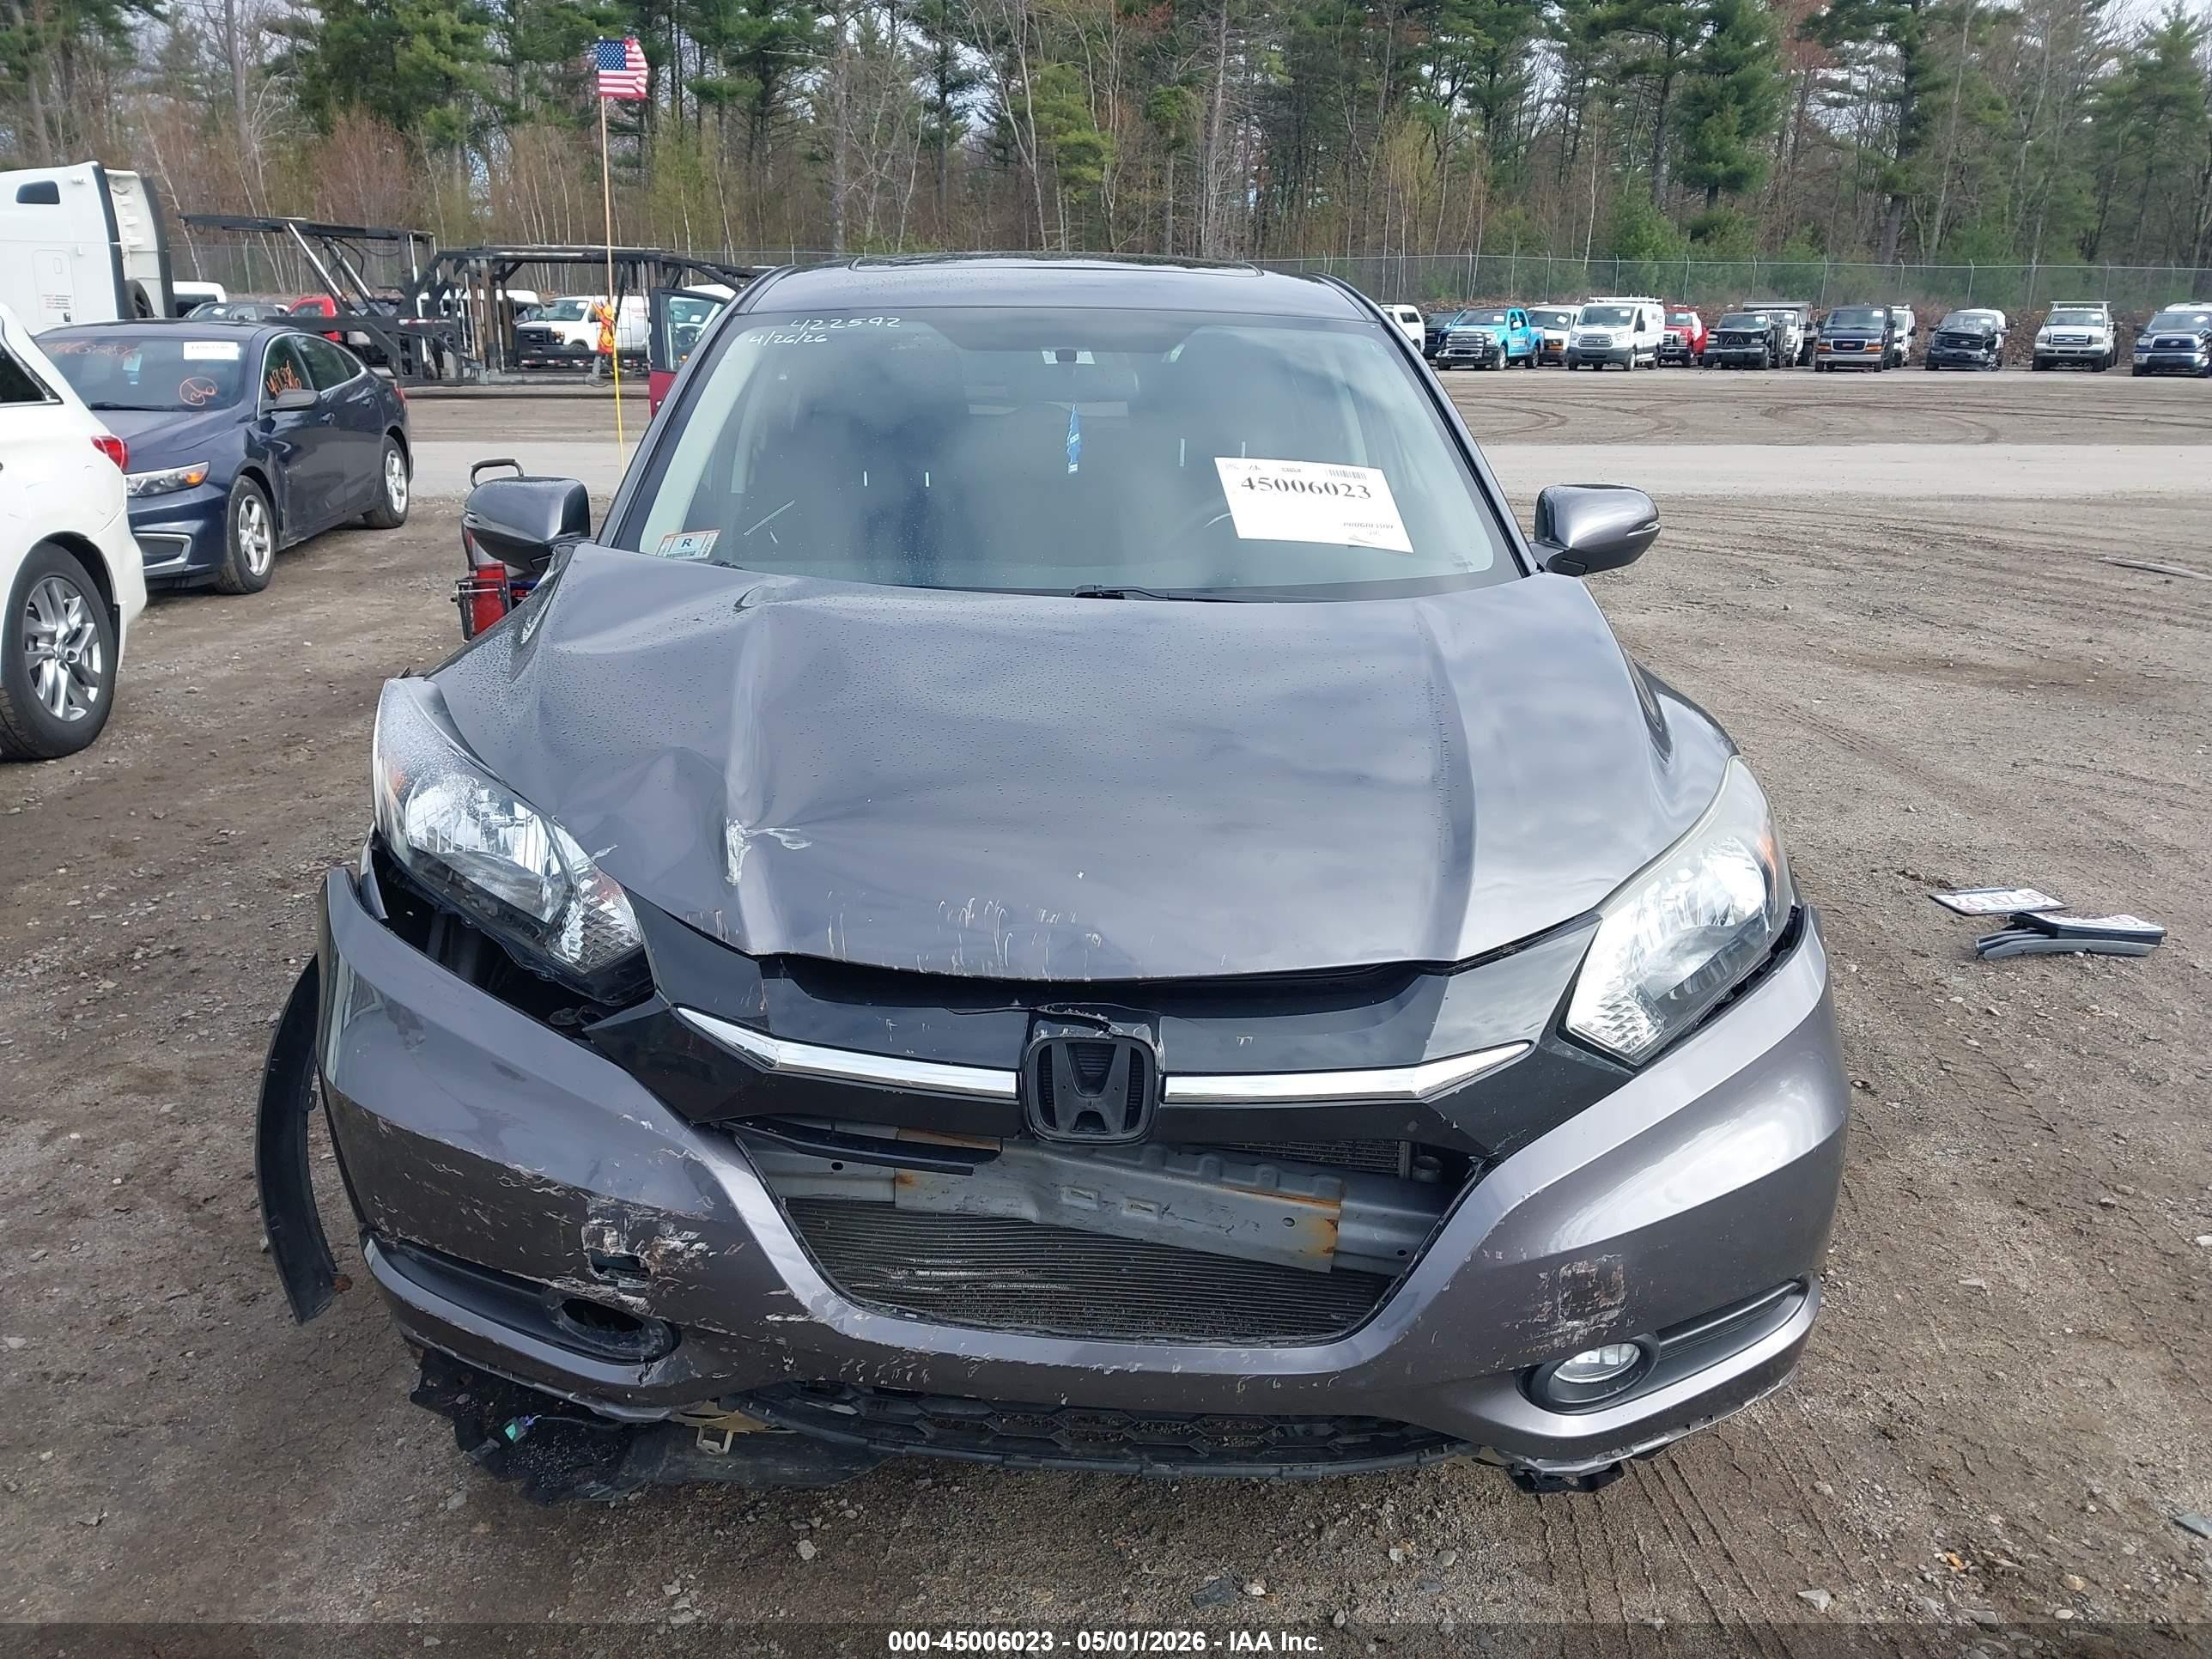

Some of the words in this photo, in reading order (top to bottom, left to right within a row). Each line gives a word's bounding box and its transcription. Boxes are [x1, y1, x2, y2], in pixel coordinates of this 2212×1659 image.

[789, 317, 901, 331] 422592
[749, 331, 829, 346] 4/26/26
[1240, 477, 1371, 499] 45006023
